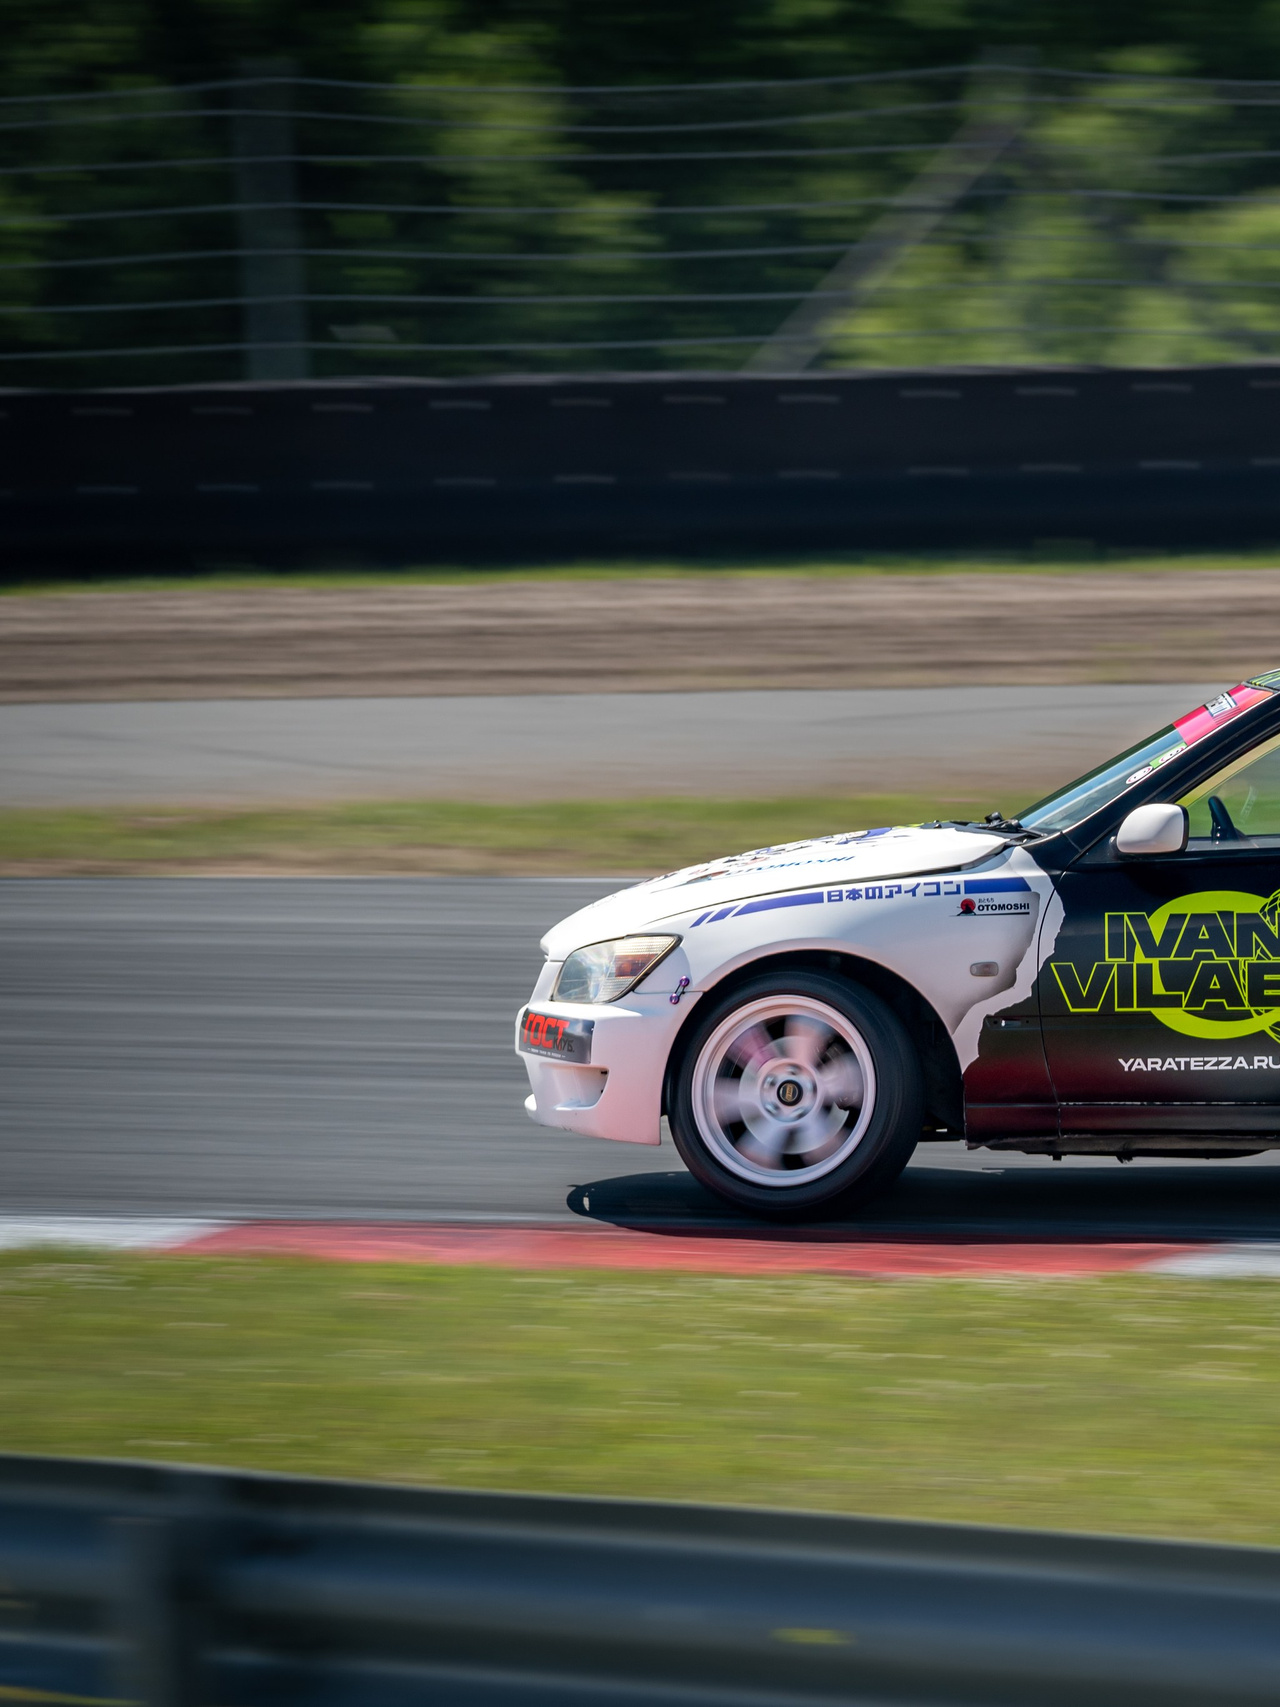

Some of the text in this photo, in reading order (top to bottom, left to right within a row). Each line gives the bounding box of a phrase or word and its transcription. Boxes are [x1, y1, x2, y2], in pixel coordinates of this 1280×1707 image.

[827, 880, 961, 901] 日本のアイコン
[977, 902, 1030, 912] OTOMOSHI
[523, 1013, 570, 1050] ГОСТ
